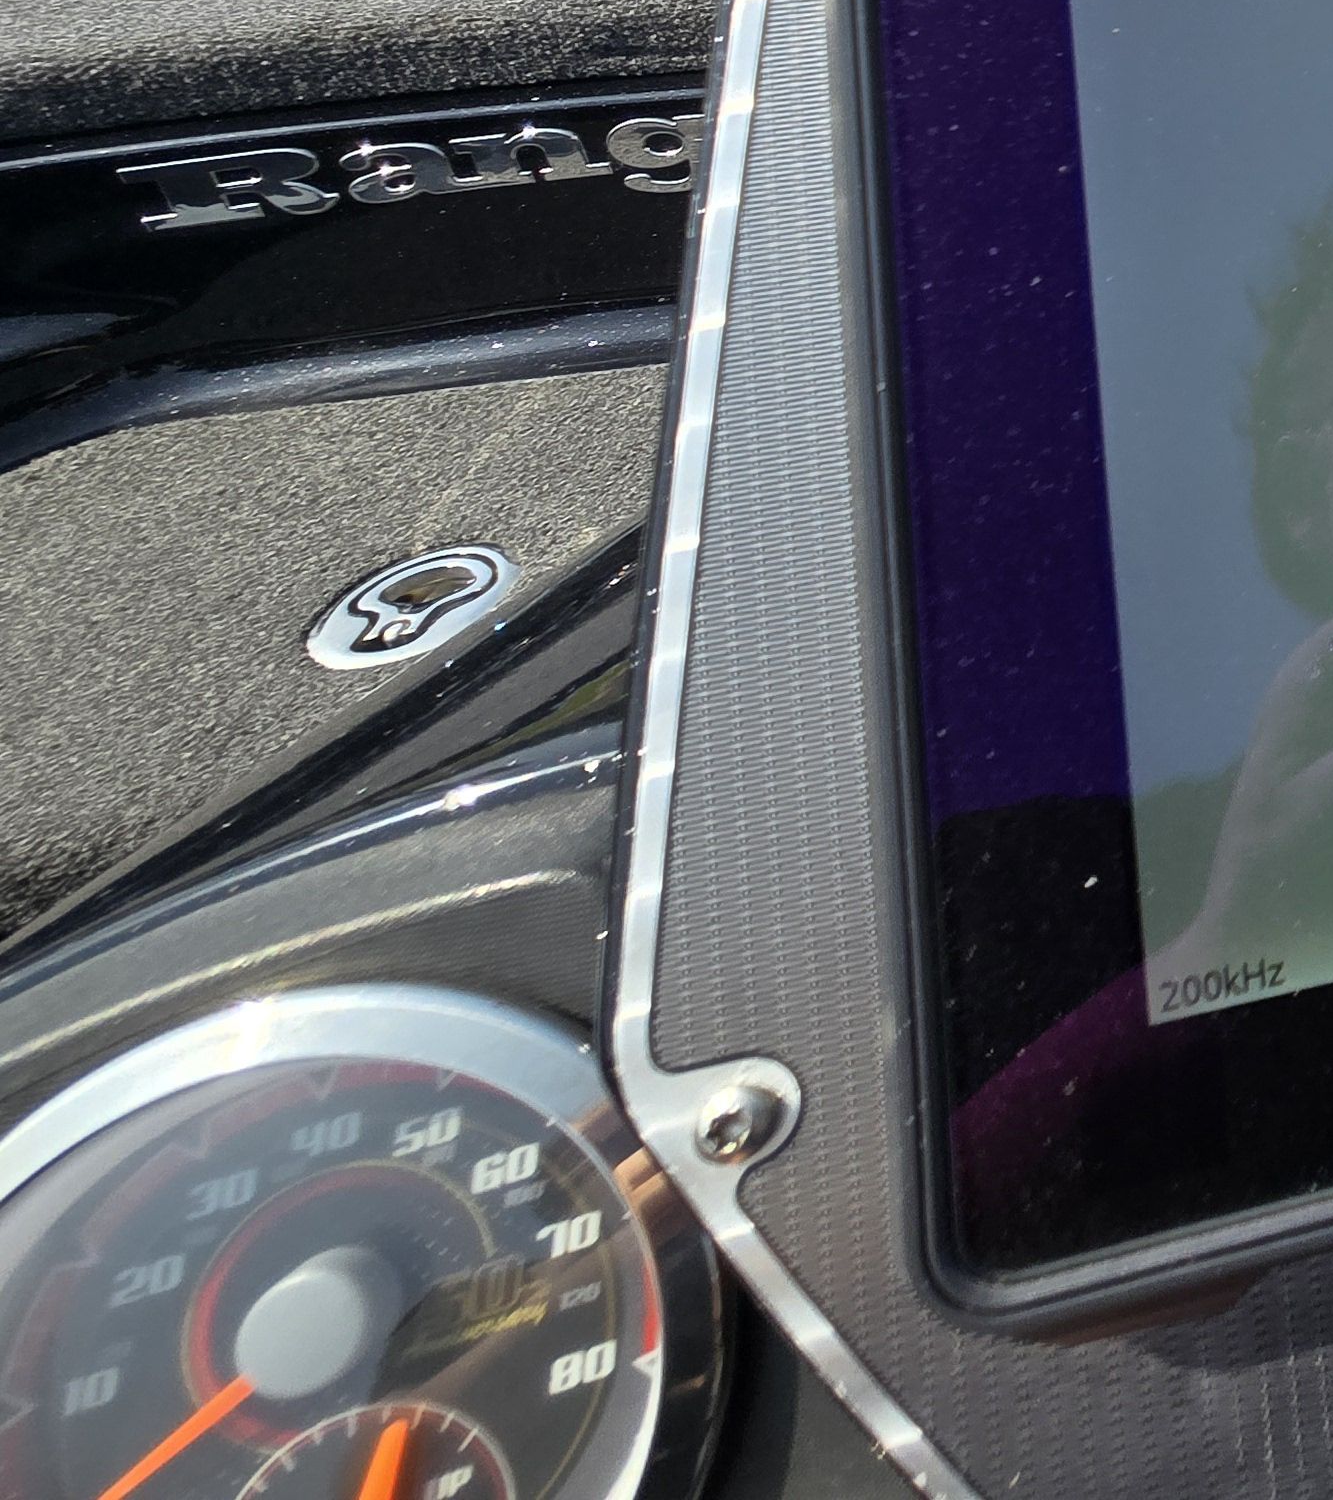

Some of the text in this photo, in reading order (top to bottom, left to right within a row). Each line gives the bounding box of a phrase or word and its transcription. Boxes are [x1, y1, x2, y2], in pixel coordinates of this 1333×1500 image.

[1158, 958, 1285, 1013] 200kHz
[291, 1112, 361, 1157] 40
[392, 1107, 463, 1157] 50
[470, 1141, 540, 1195] 60
[185, 1169, 258, 1221] 30
[535, 1209, 602, 1258] 70
[109, 1254, 186, 1309] 20
[62, 1366, 120, 1418] 10
[548, 1339, 617, 1395] 80
